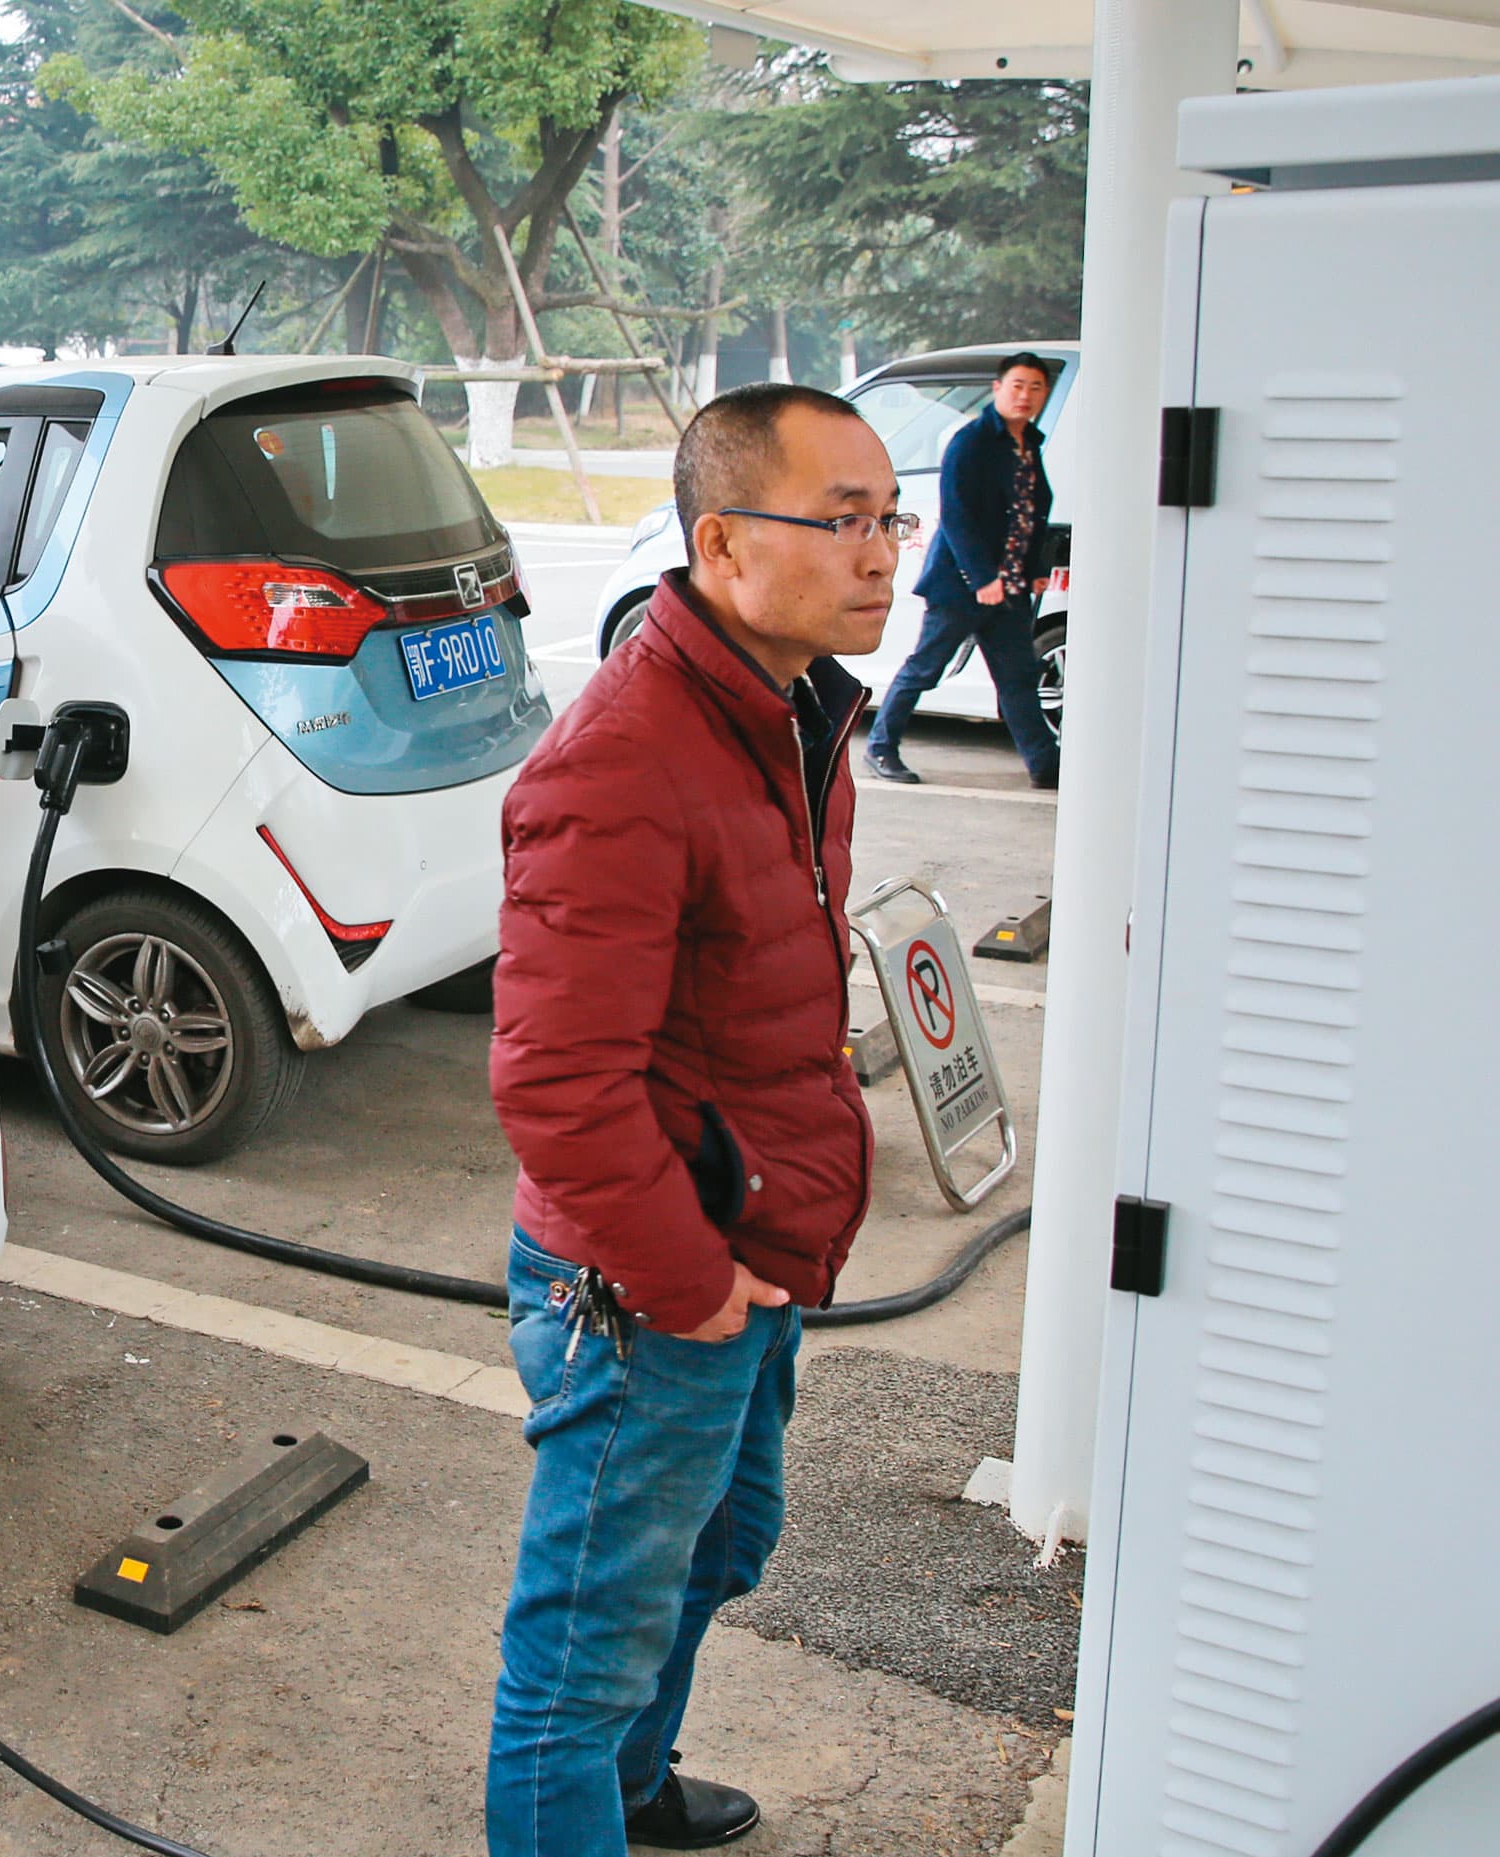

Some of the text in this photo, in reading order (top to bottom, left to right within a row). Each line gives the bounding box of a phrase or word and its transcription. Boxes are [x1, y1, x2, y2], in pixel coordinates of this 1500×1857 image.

[929, 1045, 979, 1101] 请勿泊车
[940, 1084, 989, 1134] NO PARKING
